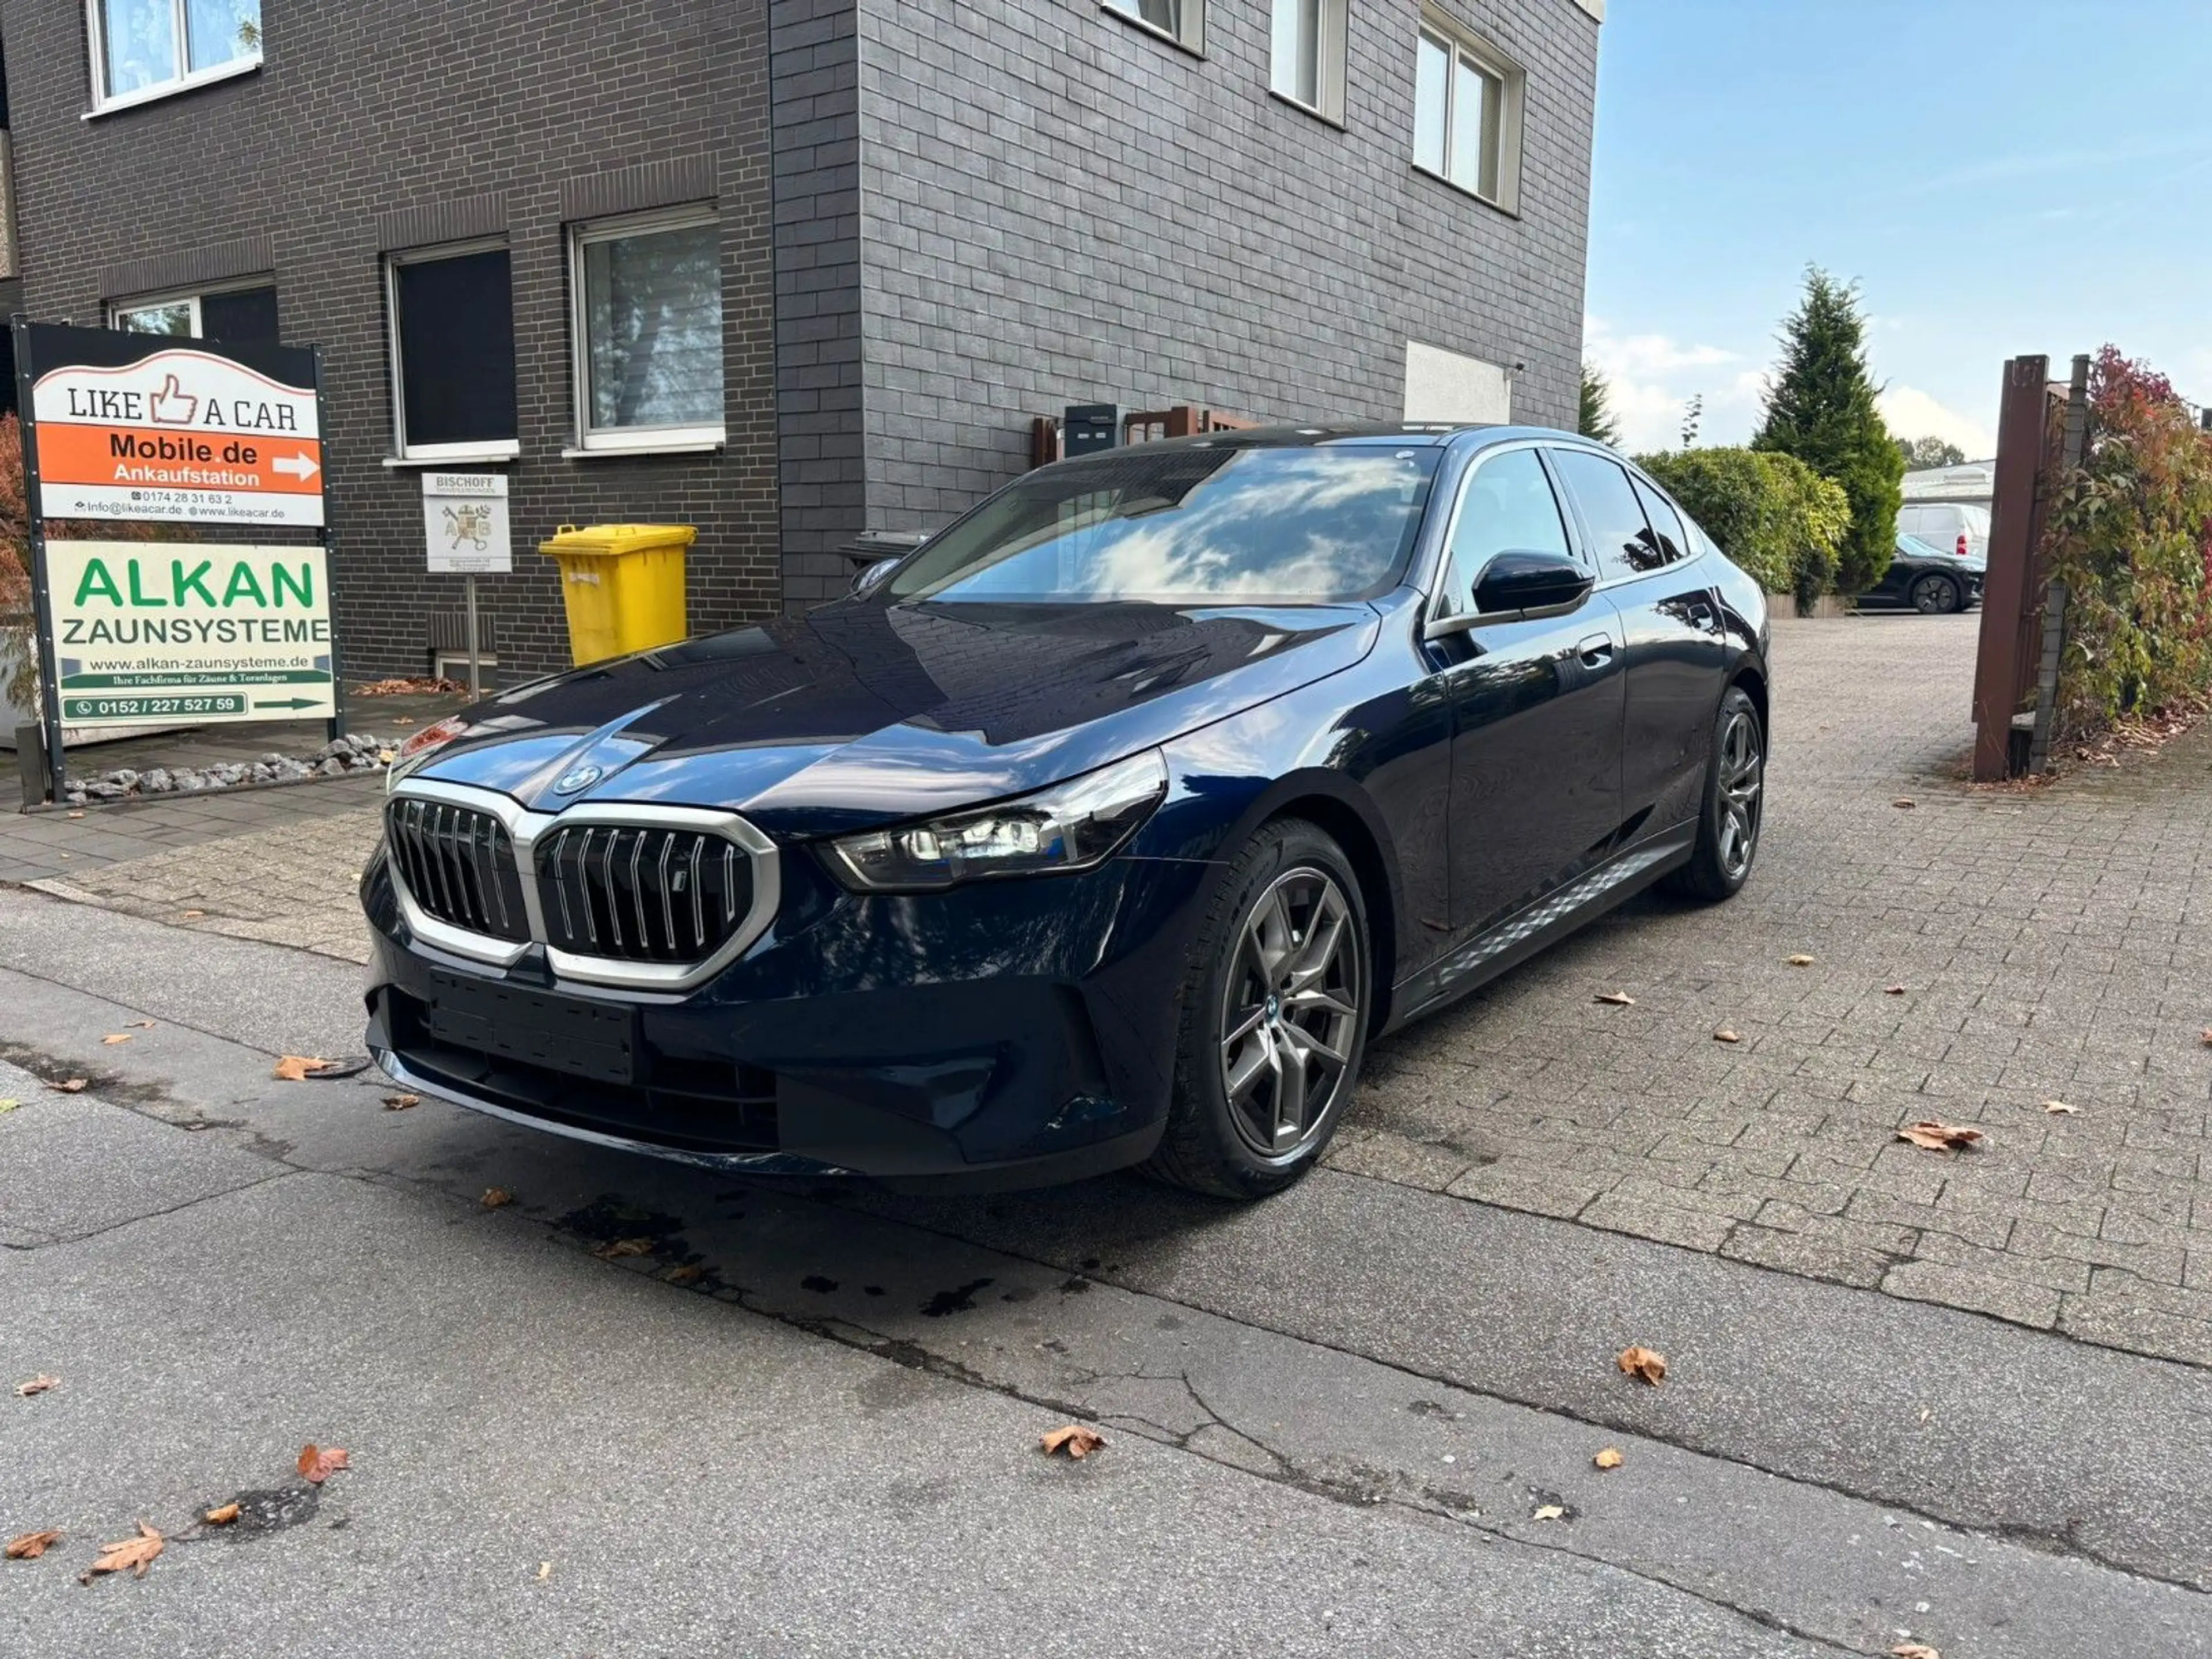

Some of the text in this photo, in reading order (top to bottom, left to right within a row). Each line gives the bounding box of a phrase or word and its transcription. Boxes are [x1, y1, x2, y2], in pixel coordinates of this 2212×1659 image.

[67, 388, 297, 431] LIKE A CAR
[110, 433, 257, 464] Mobile.de
[113, 464, 260, 487] Ankaufstation
[437, 476, 494, 487] BISCHOFF
[143, 491, 232, 505] 0174 28 31 63 2
[199, 507, 285, 518] www.likeacar.de
[74, 558, 313, 608] ALKAN
[62, 619, 330, 645] ZAUNSYSTEME
[90, 656, 308, 671] www.alkan-zaunsysteme.de
[113, 673, 287, 685] Ihre Fachfirma für Zäune & Toranlagen
[99, 698, 235, 714] 0152 / 227 527 59
